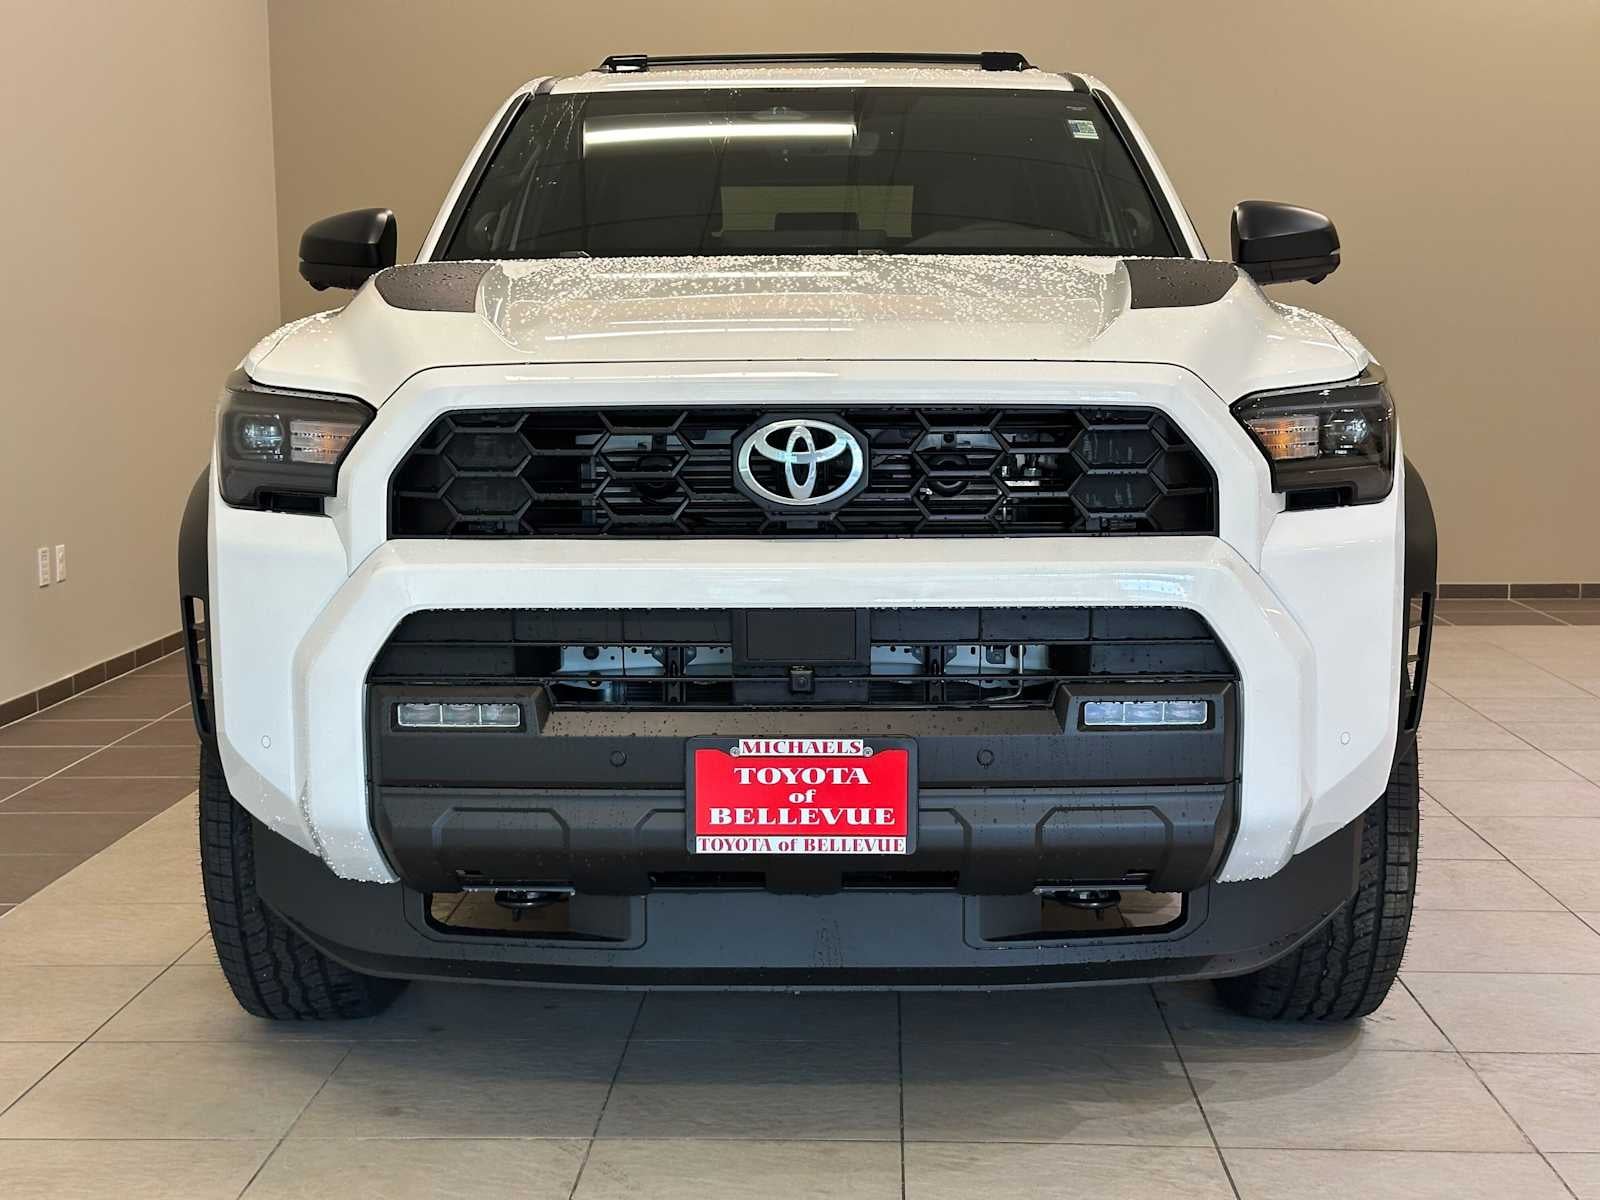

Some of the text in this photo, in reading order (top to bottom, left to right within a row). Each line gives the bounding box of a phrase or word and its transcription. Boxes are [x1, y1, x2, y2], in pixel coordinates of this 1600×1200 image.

[742, 741, 862, 754] MICHAELS
[734, 767, 871, 785] TOYOTA
[788, 789, 816, 804] of
[708, 807, 896, 825] BELLEVUE
[698, 838, 905, 852] TOYOTA of BELLEVUE
